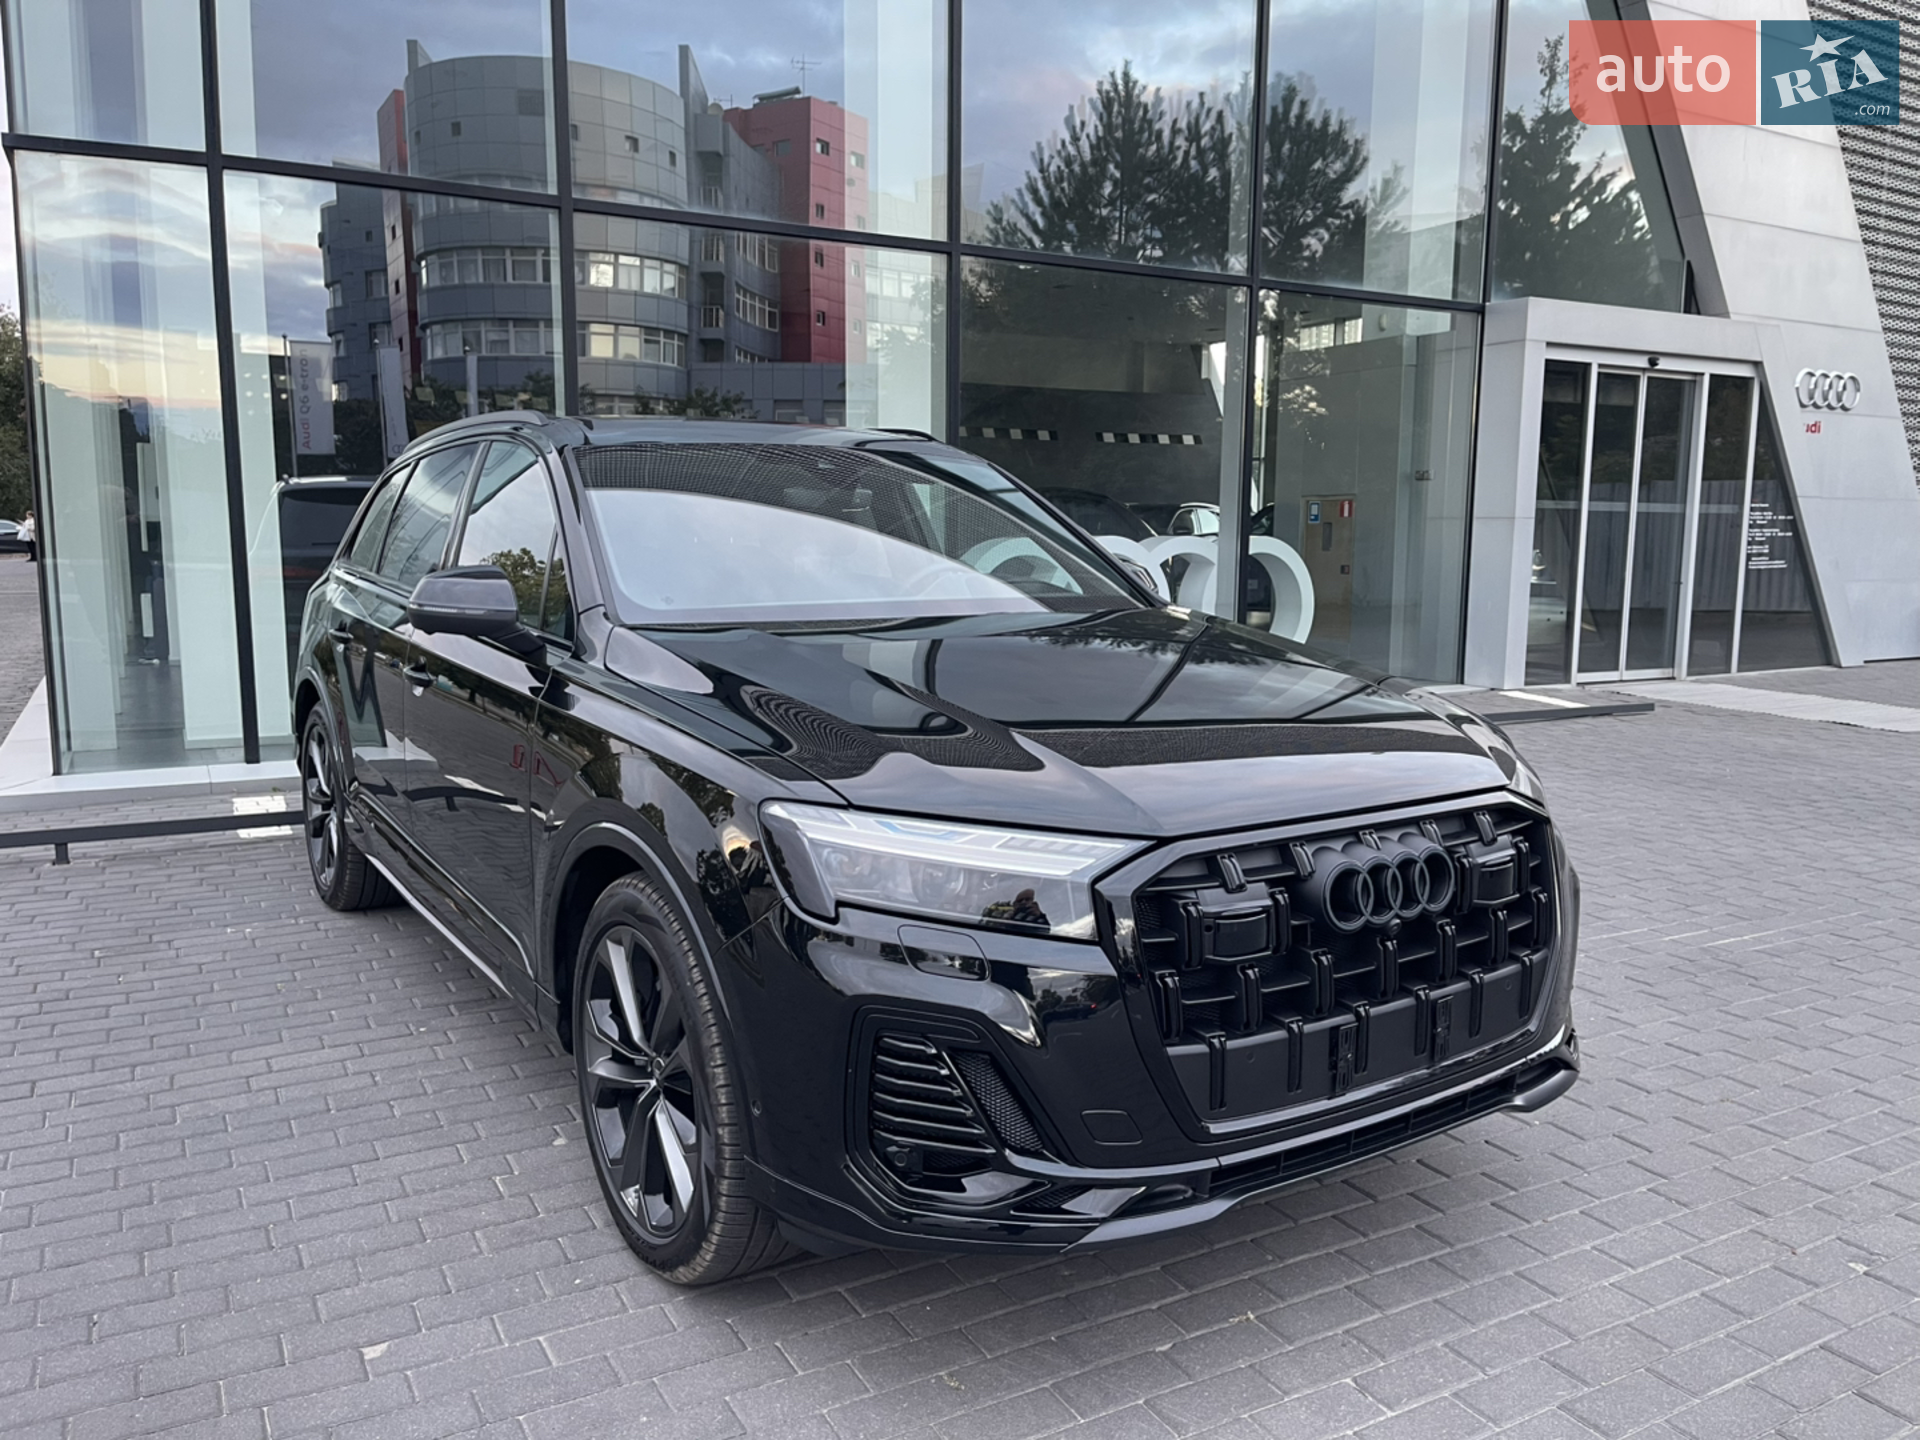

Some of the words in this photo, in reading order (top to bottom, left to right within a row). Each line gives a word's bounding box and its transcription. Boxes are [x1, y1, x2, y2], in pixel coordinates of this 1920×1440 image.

[299, 349, 310, 391] e-tron
[301, 418, 312, 450] Audi
[1805, 420, 1822, 434] di
